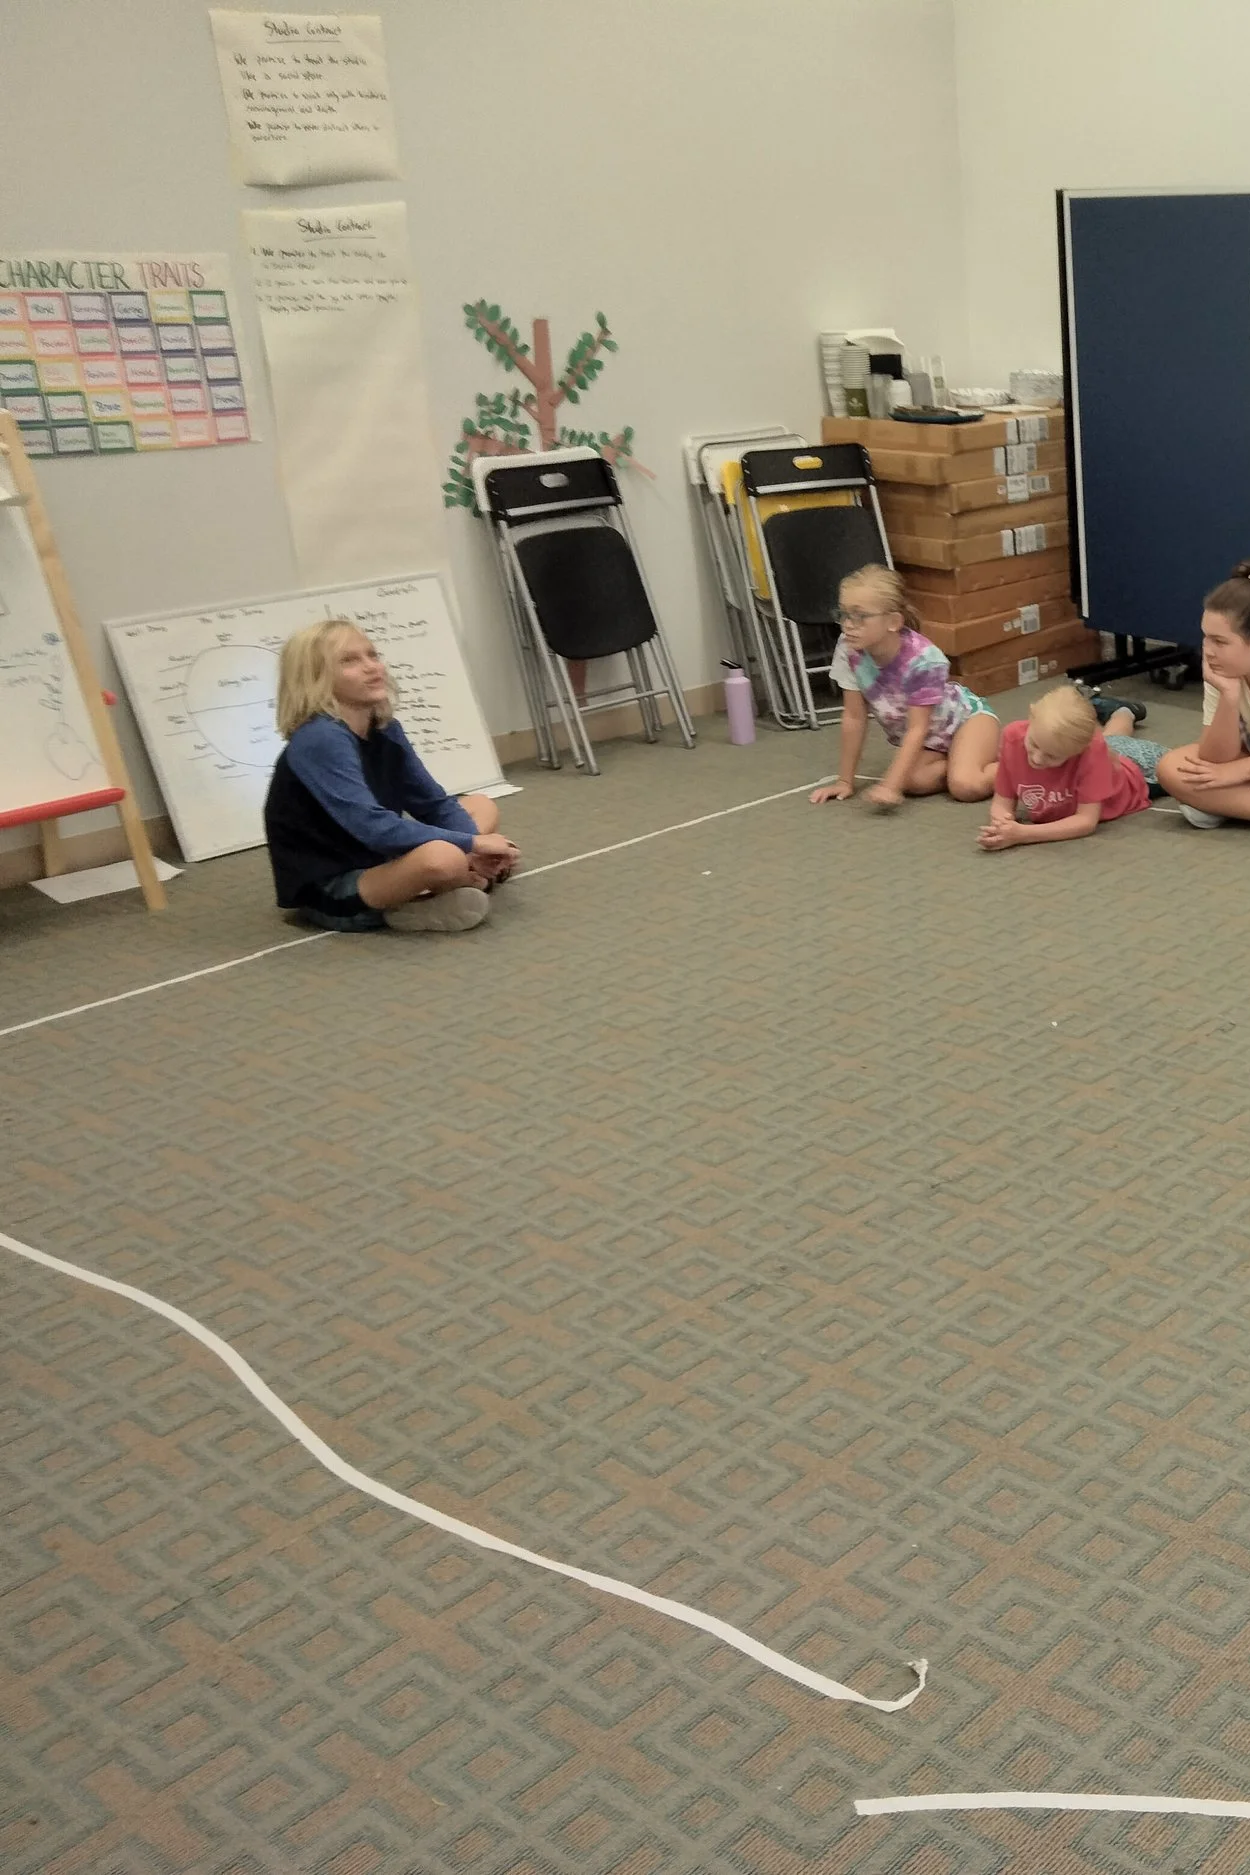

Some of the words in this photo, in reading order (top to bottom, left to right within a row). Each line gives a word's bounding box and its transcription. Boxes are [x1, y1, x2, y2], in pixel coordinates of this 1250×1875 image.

[264, 21, 300, 36] Studio
[306, 22, 342, 35] Contract
[247, 121, 261, 130] We
[297, 218, 331, 234] Studio
[337, 219, 372, 233] Contract
[0, 259, 130, 290] CHARACTER
[135, 259, 205, 289] TRAITS
